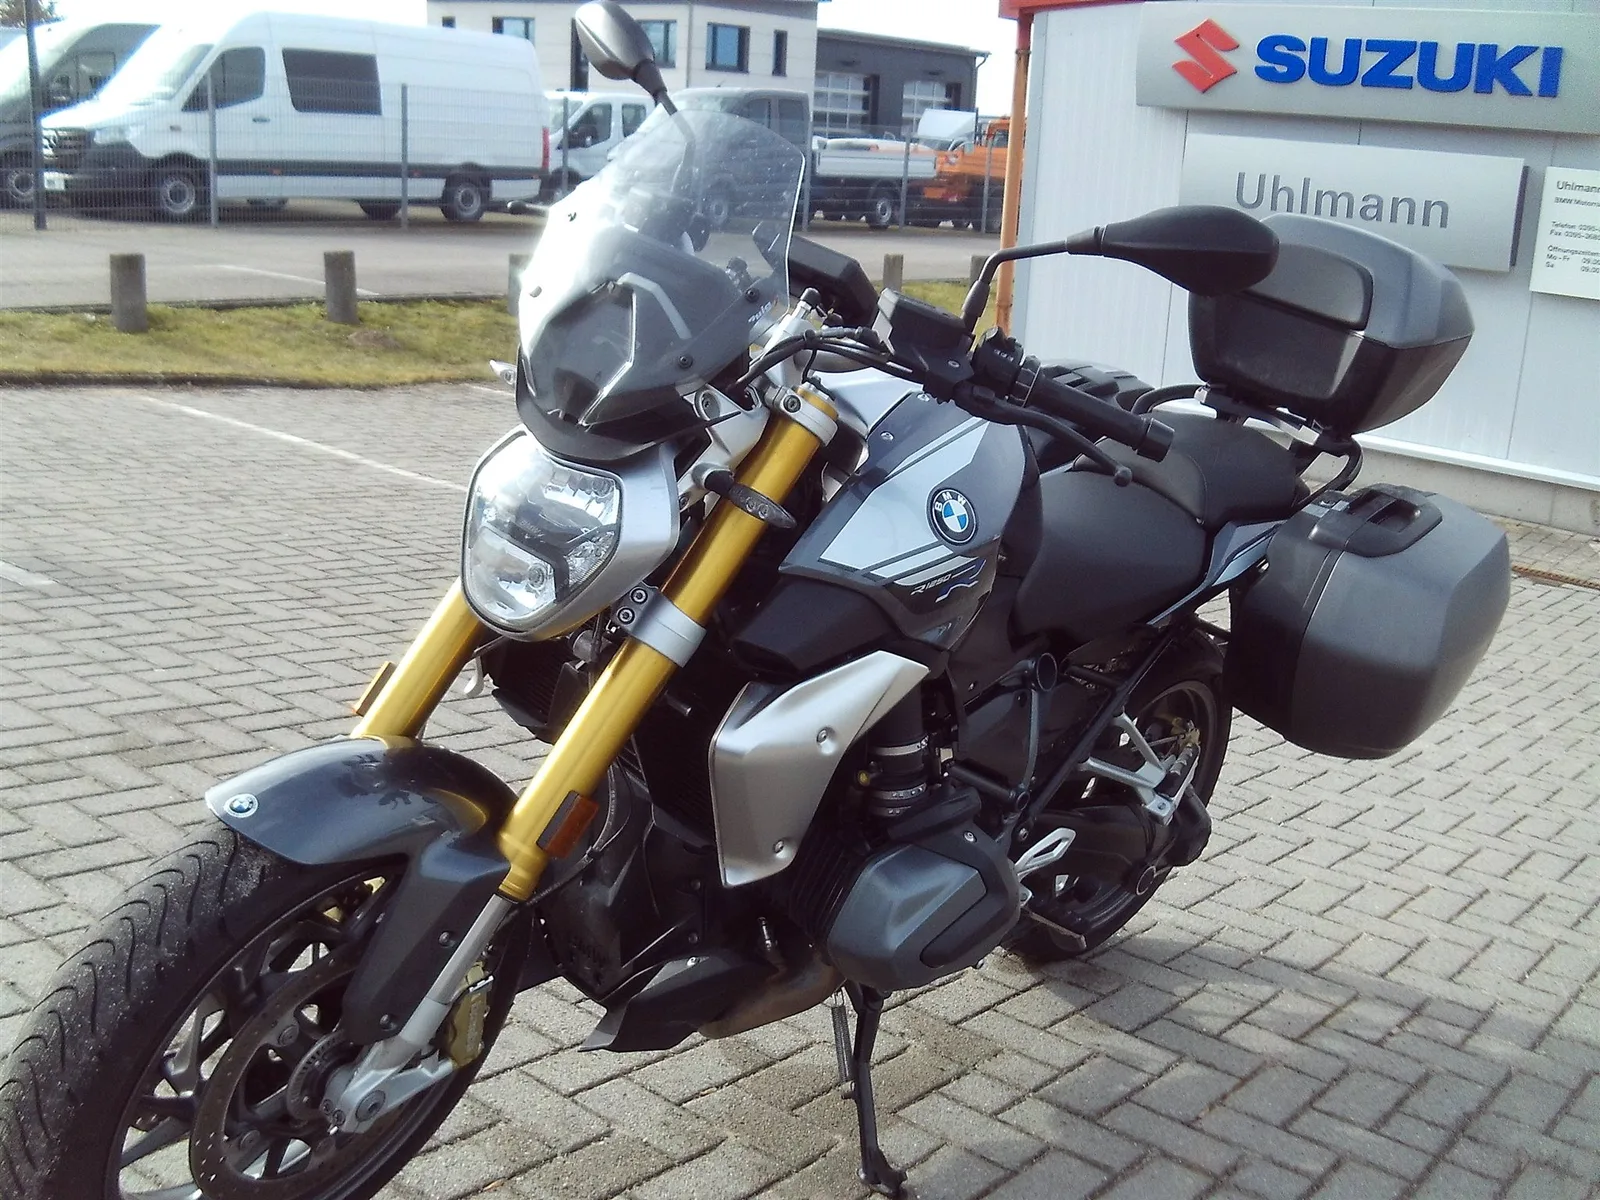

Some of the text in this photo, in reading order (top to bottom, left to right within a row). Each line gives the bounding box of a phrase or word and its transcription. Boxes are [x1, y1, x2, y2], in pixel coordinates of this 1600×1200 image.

[1254, 34, 1565, 98] SUZUKI
[1235, 171, 1449, 229] Uhlmann
[934, 491, 967, 512] BMW
